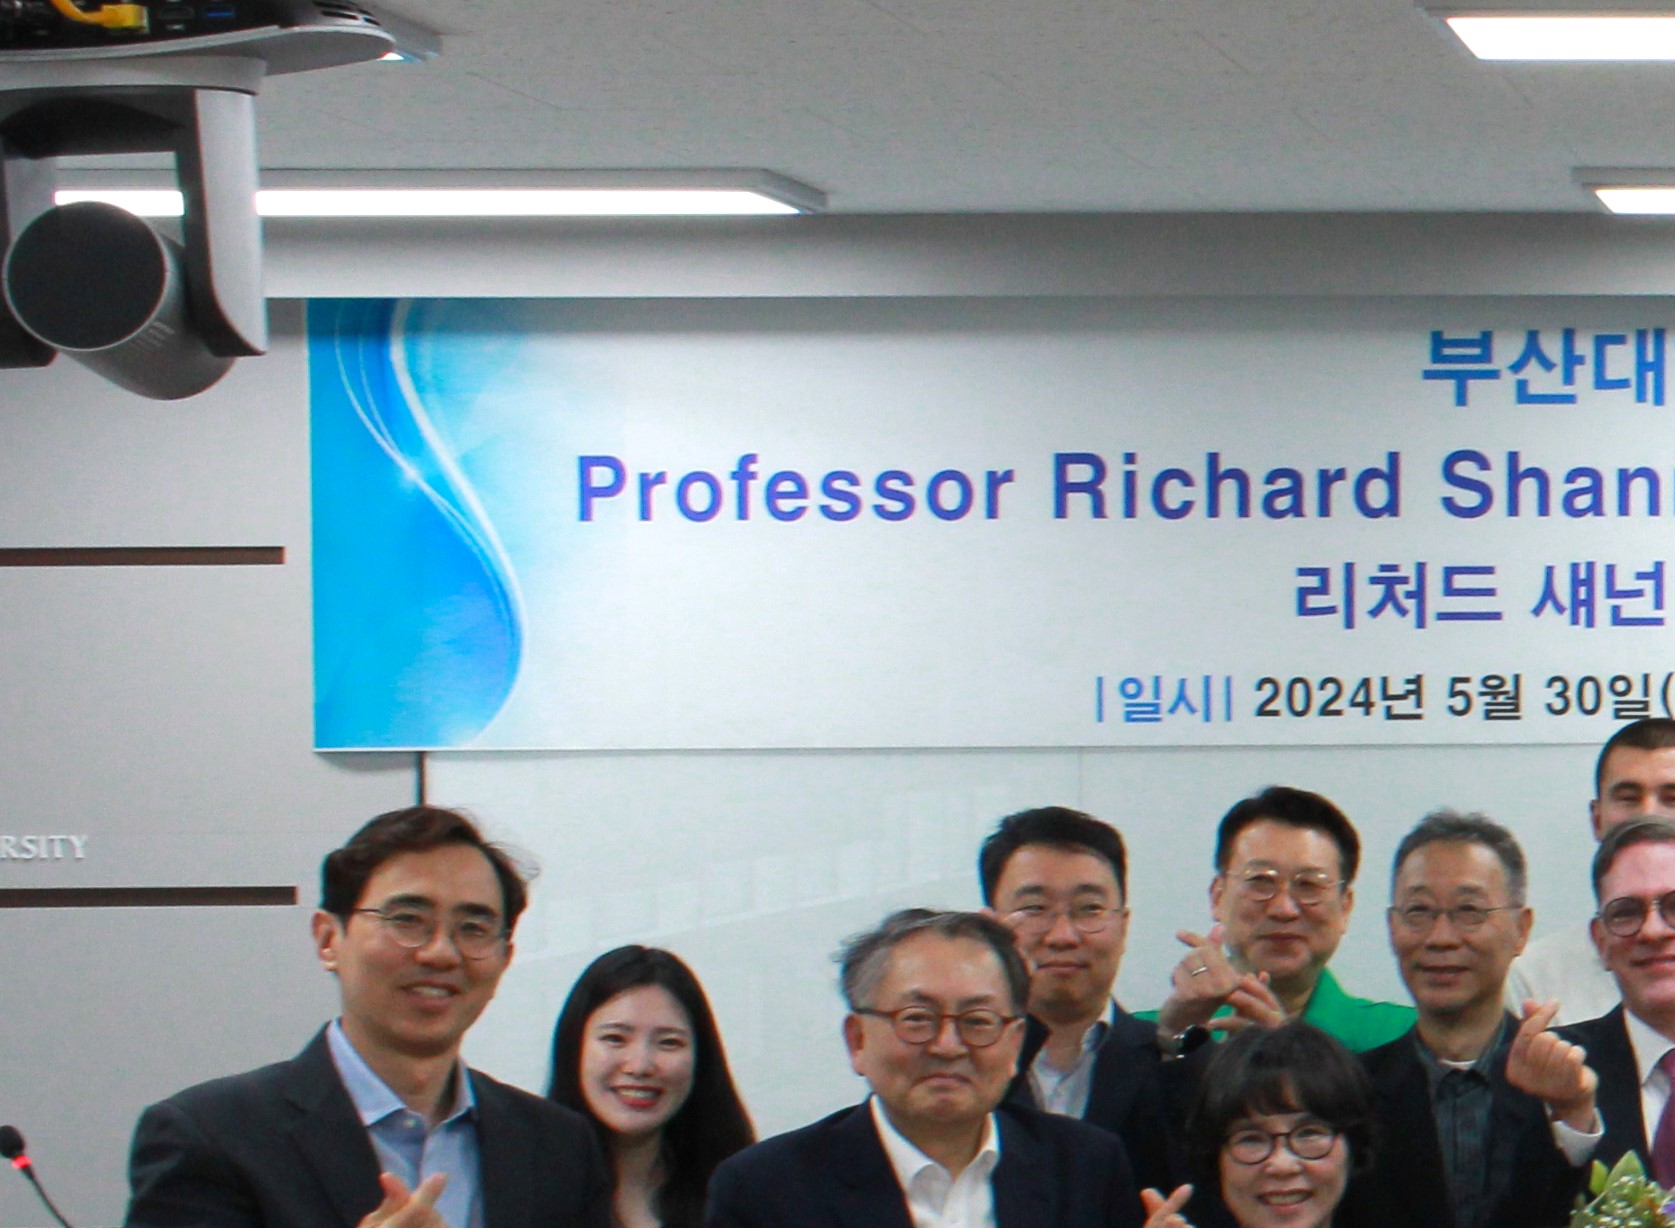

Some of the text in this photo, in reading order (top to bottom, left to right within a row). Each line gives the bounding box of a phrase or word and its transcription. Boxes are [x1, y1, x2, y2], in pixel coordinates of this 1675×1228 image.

[577, 453, 1015, 523] Professor
[1053, 451, 1401, 520] Richard
[1295, 561, 1503, 630] 리처드
[1530, 560, 1665, 629] 섀넌
[1254, 673, 1424, 721] 2024년
[1446, 673, 1522, 721] 5월
